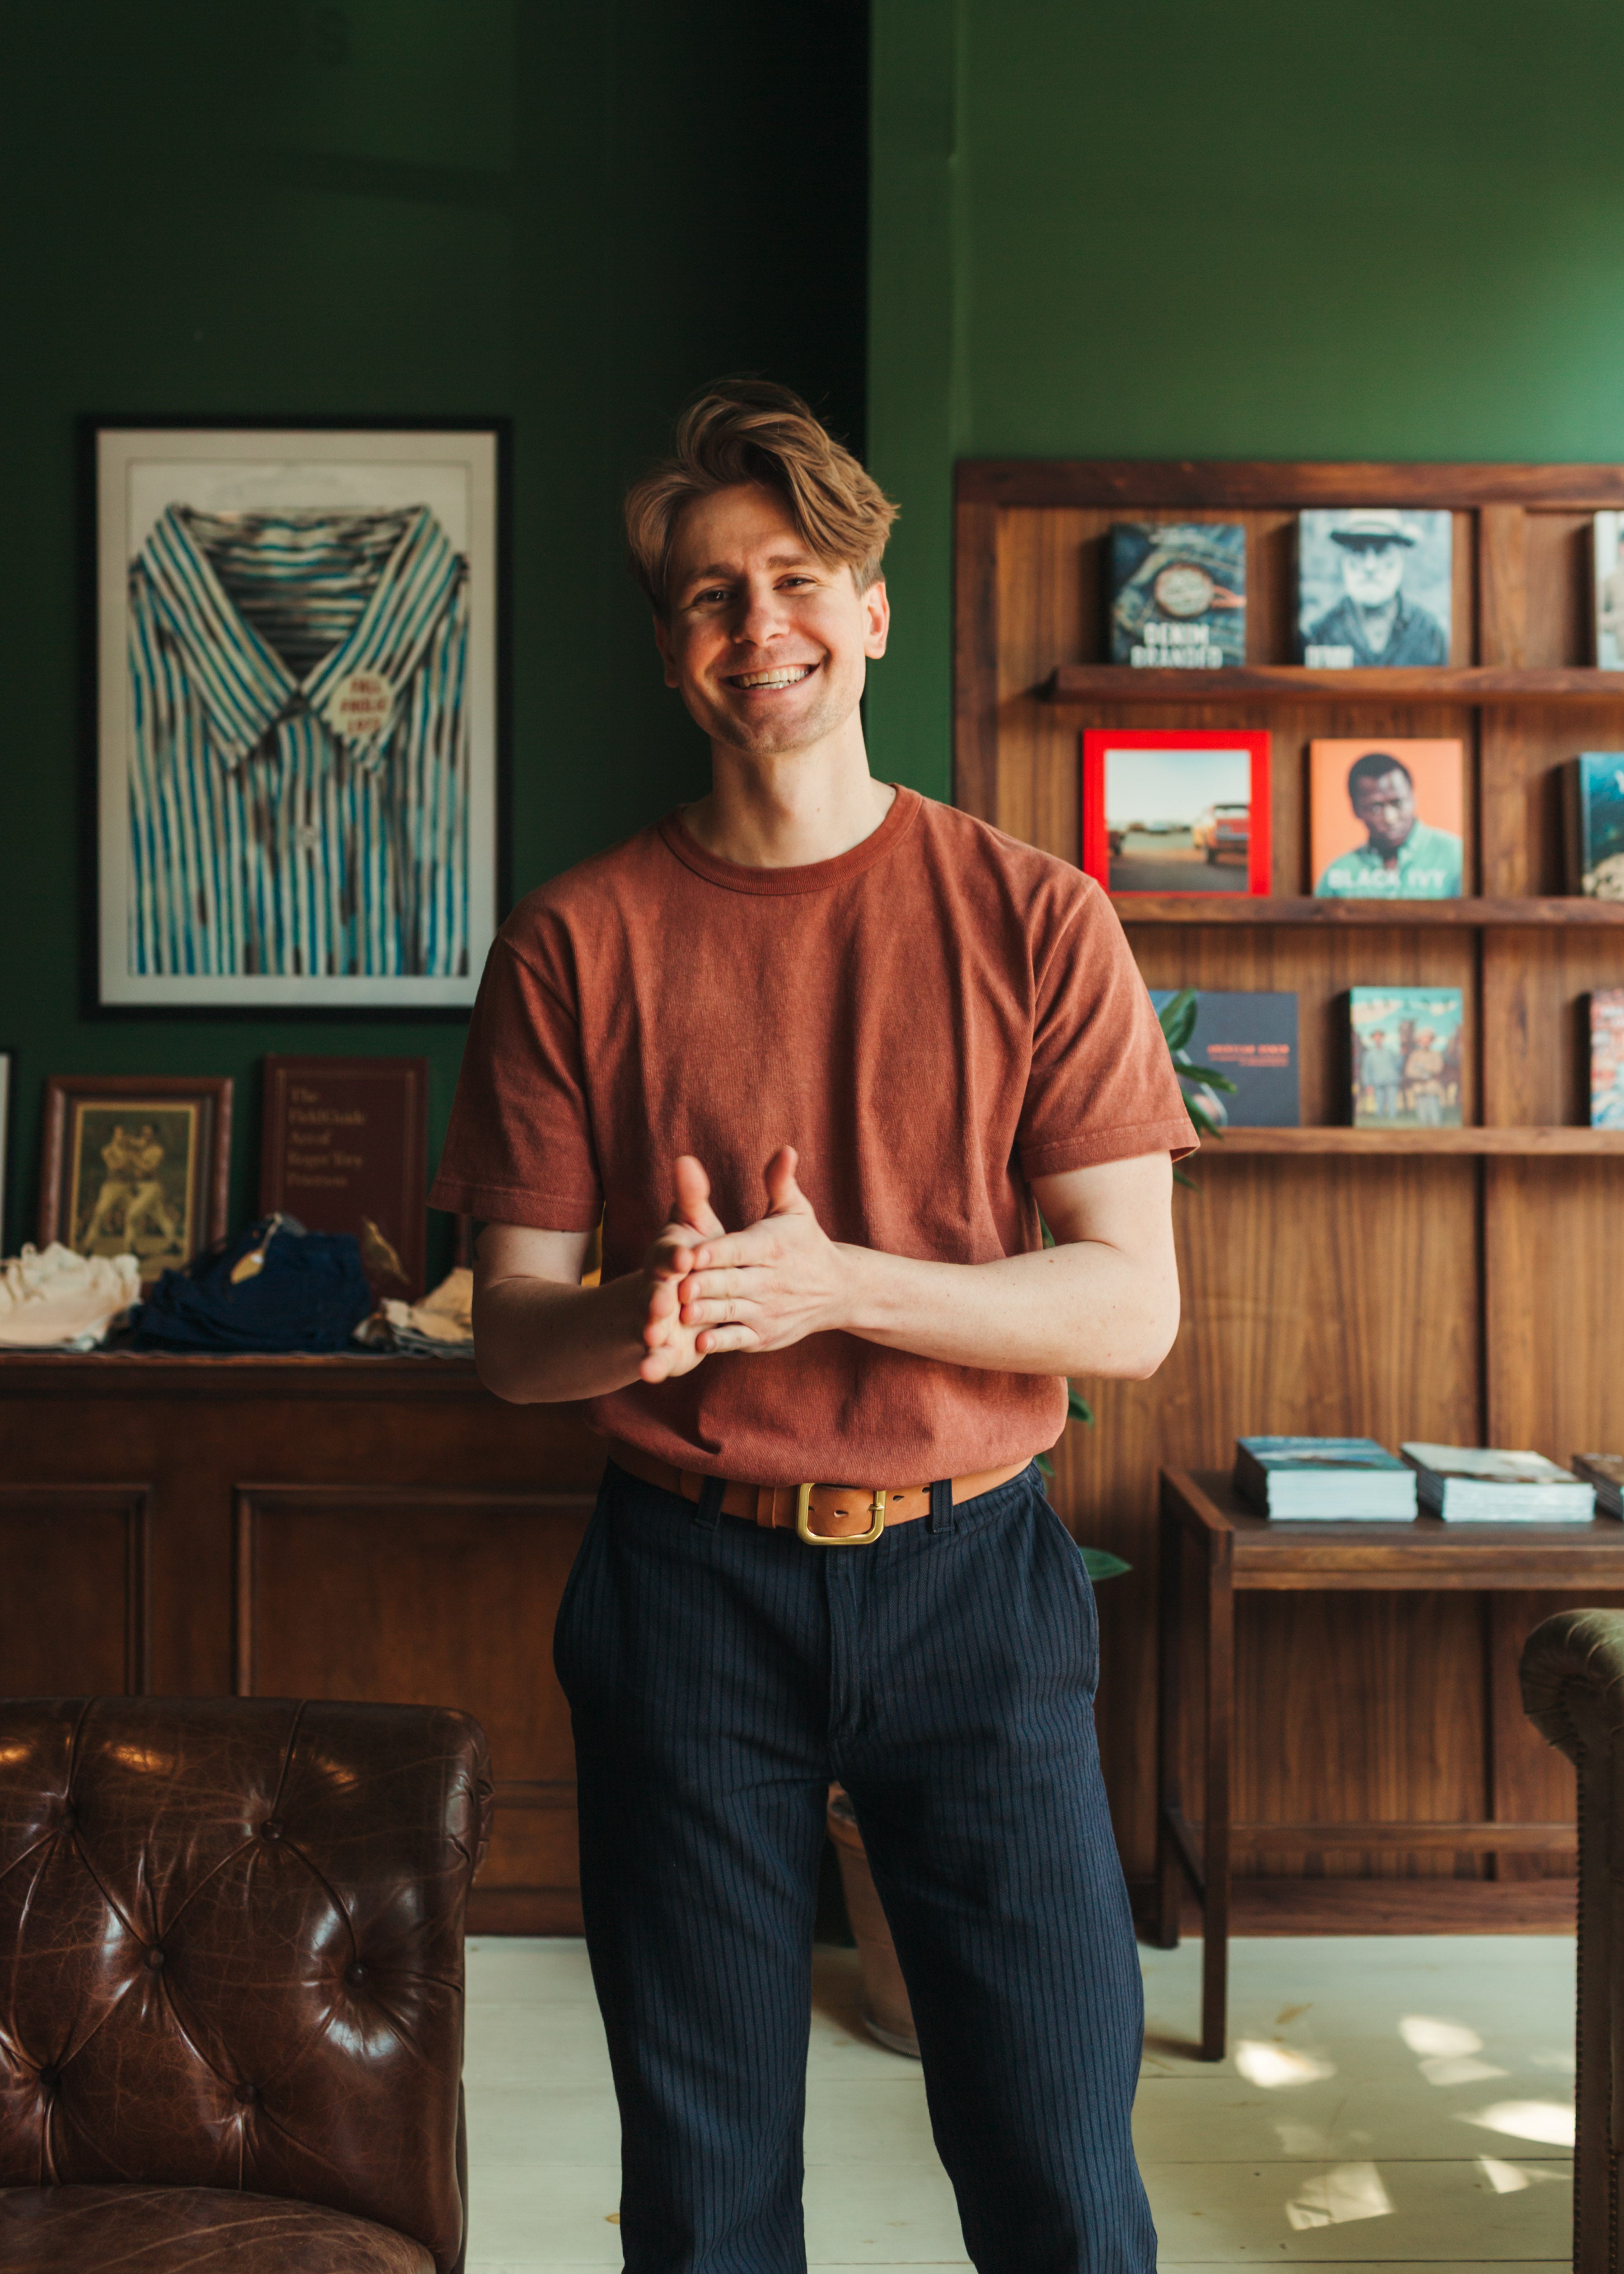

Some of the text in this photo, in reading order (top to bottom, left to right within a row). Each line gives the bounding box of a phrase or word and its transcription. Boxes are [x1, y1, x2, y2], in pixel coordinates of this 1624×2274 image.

[1144, 622, 1209, 645] DENIM
[1131, 646, 1223, 668] BRANDED
[1328, 869, 1447, 889] BLACK IVY
